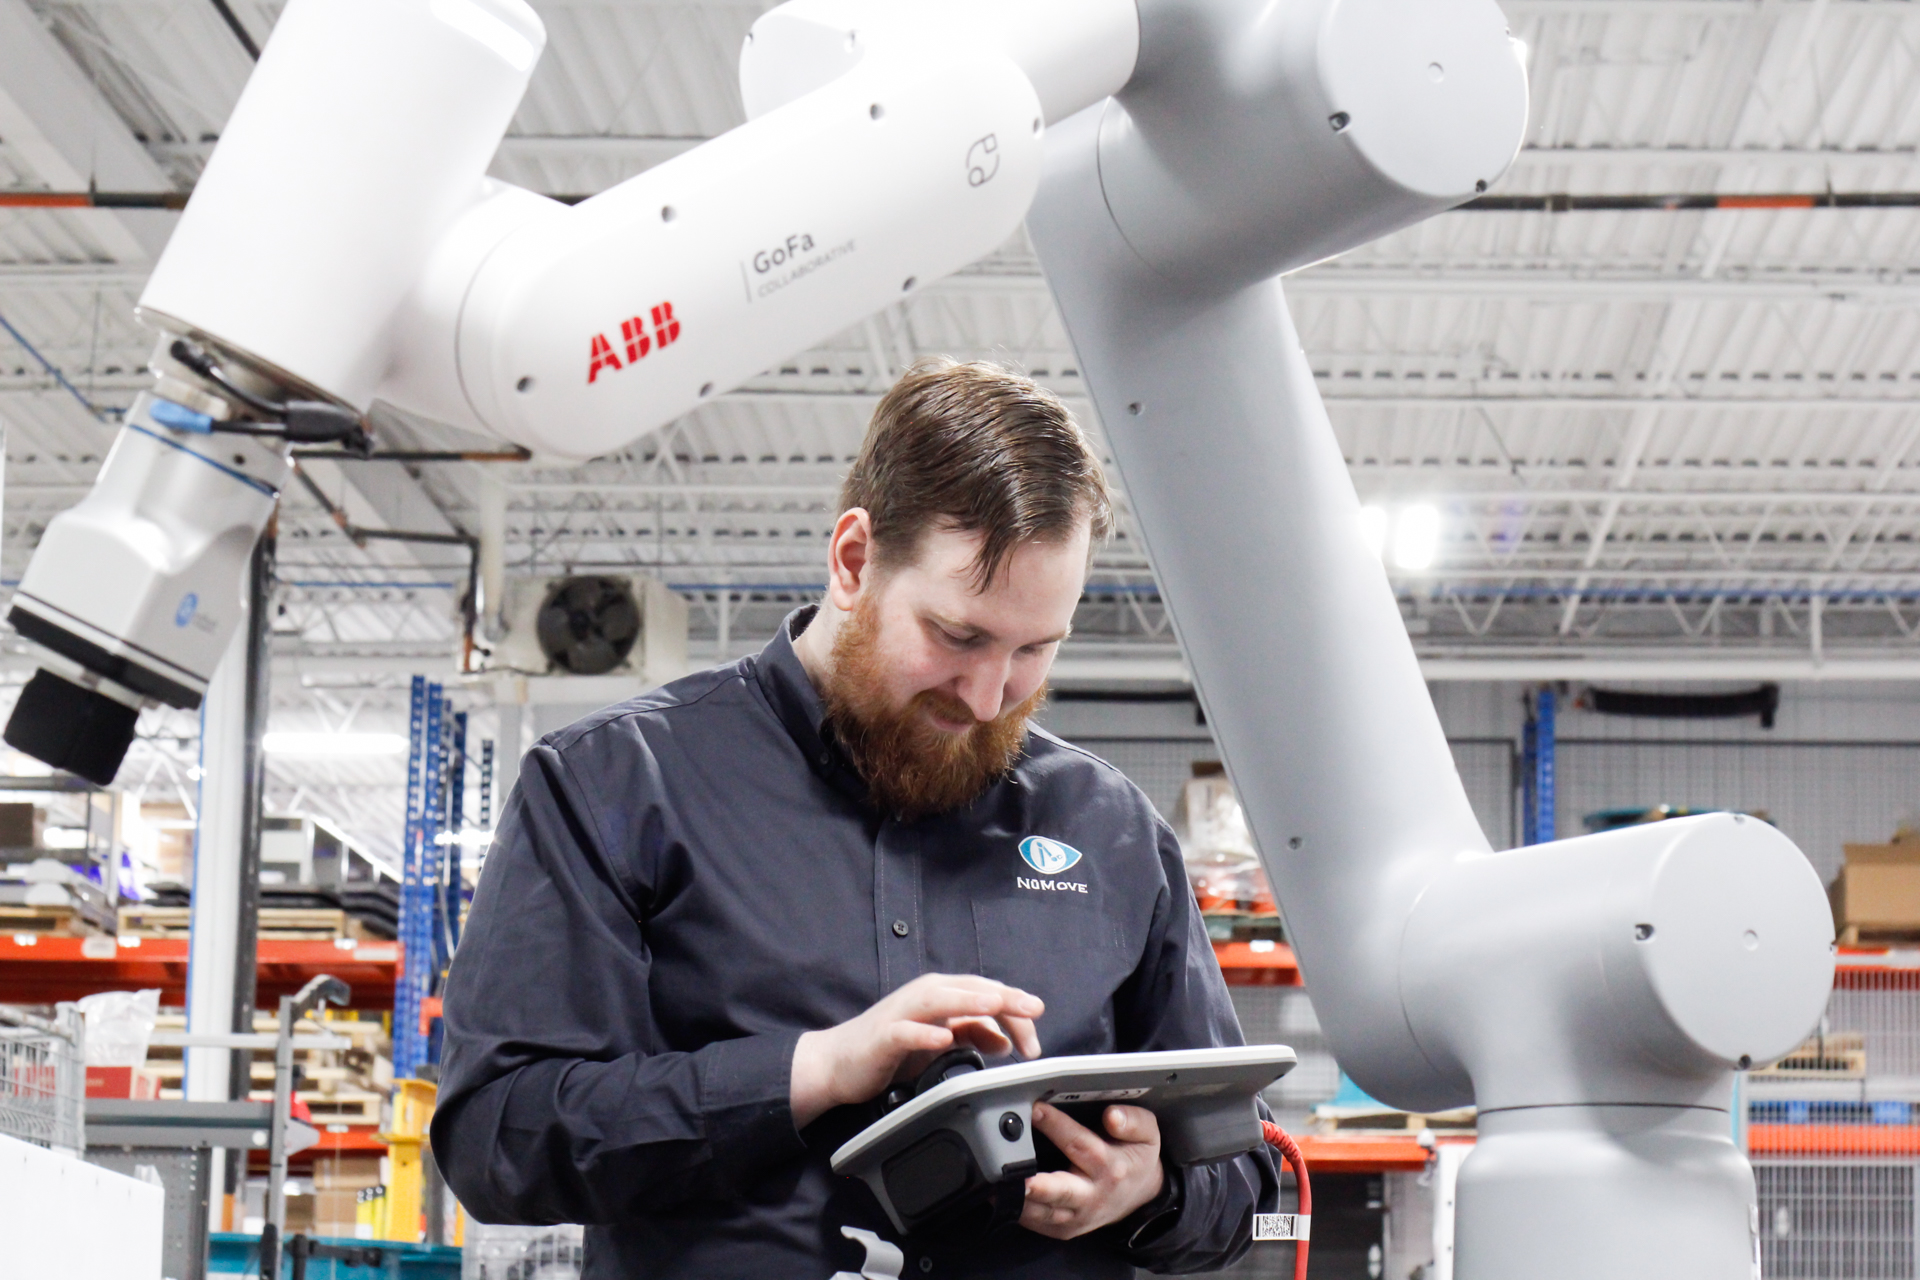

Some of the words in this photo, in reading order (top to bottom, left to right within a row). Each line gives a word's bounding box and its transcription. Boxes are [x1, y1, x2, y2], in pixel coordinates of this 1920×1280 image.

[753, 234, 814, 274] GoFa
[757, 239, 857, 298] COLLABORATIVE
[588, 301, 680, 384] ABB
